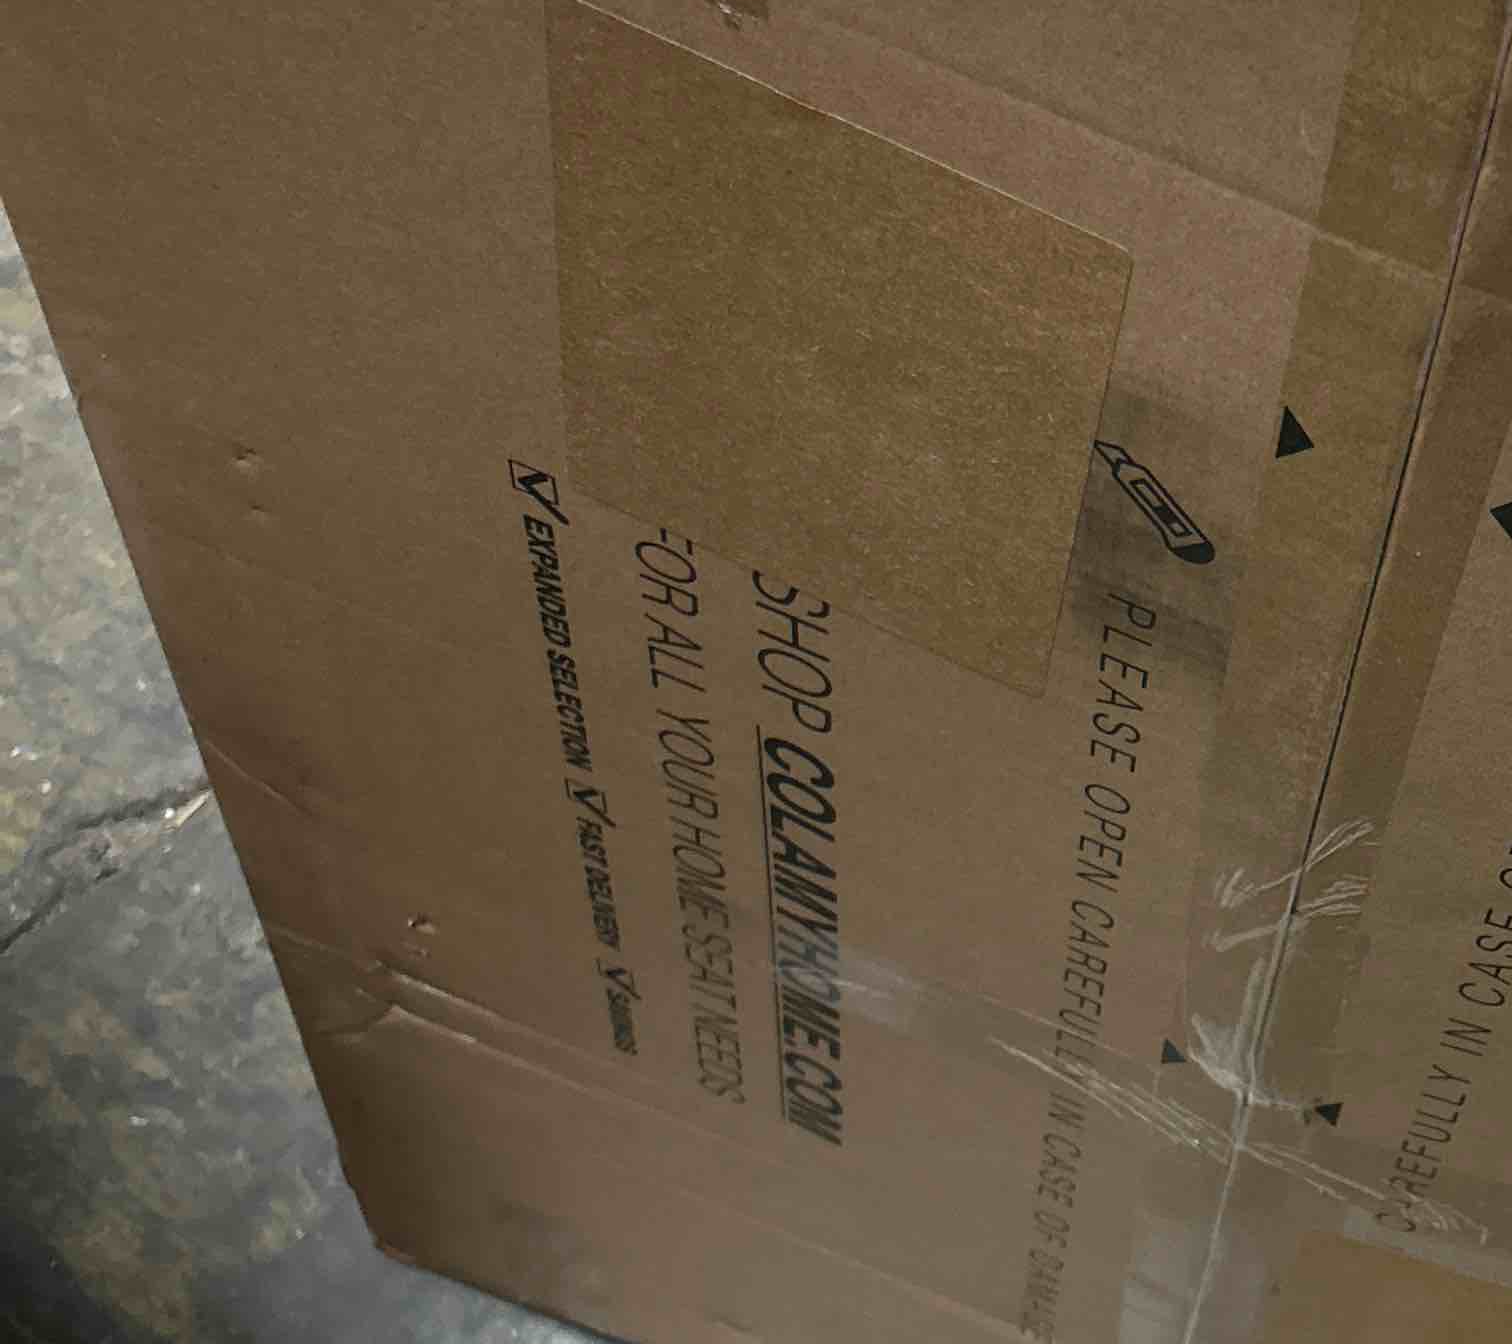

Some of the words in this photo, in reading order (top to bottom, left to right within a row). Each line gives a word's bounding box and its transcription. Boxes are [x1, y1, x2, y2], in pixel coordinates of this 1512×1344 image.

[523, 513, 571, 649] EXPANDED
[635, 527, 699, 617] OR
[644, 612, 706, 693] ALL
[1090, 592, 1157, 773] PLEASE
[546, 648, 592, 772] SELECTION
[656, 708, 720, 820] YOUR
[669, 816, 729, 928] HOME
[1074, 783, 1131, 894] OPEN
[764, 737, 843, 1147] COLAMYHOME.COM
[693, 1008, 746, 1105] NEEDS
[1440, 1017, 1492, 1056] IN
[1047, 1090, 1087, 1126] IN
[1036, 1132, 1081, 1208] CASE
[1032, 1208, 1071, 1249] OF
